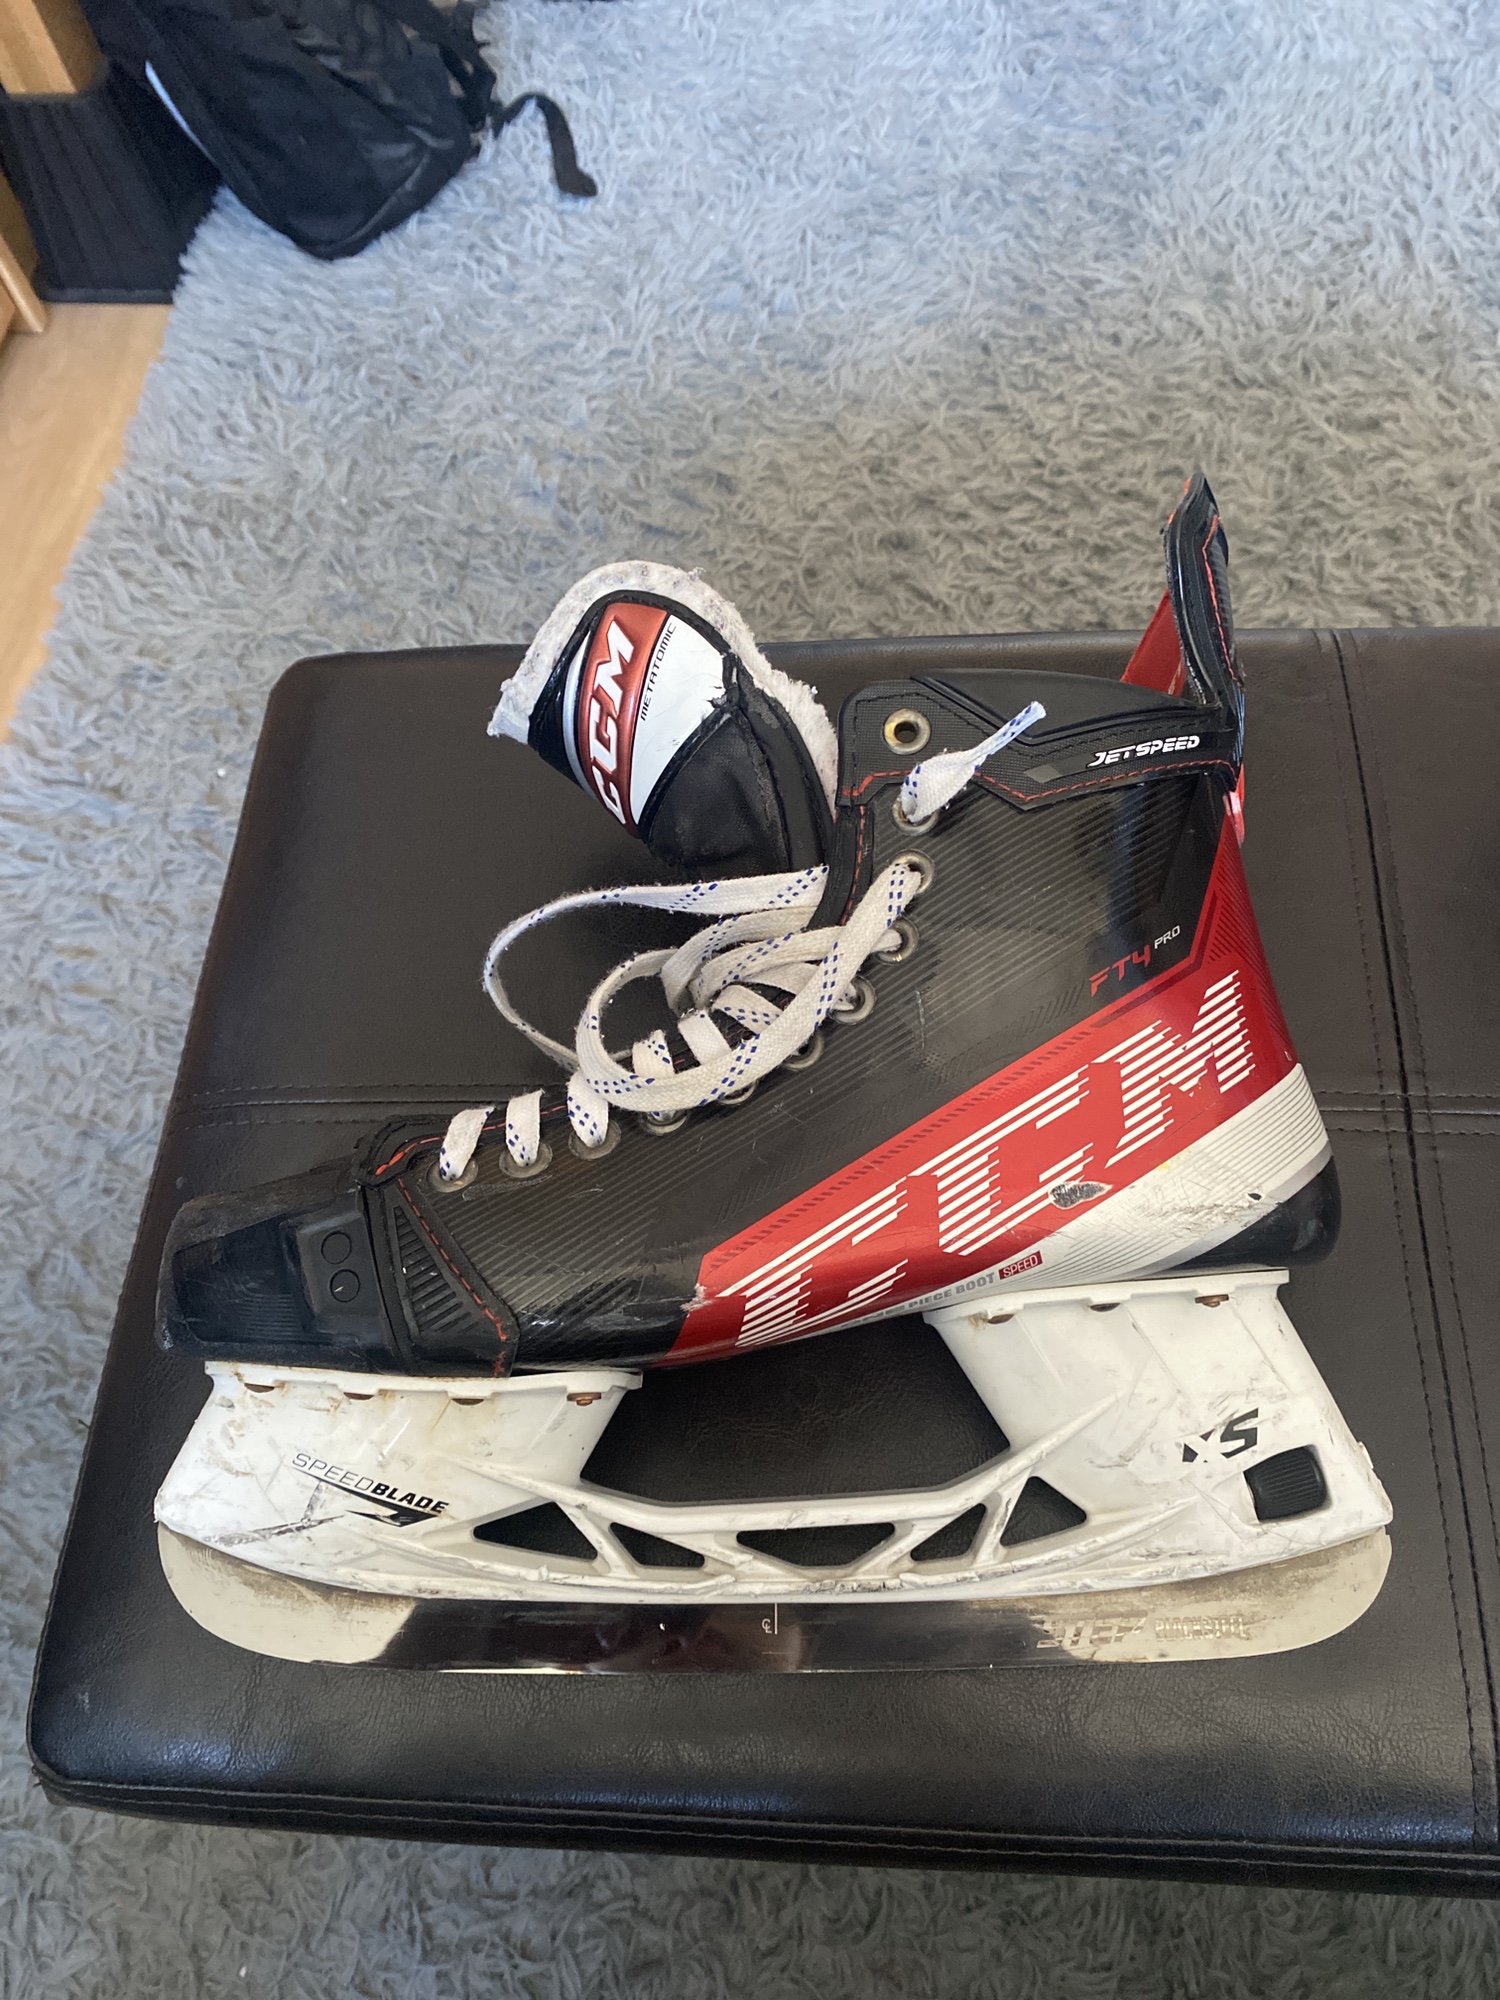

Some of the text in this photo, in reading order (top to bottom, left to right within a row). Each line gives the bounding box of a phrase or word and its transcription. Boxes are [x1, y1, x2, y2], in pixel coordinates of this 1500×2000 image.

[640, 622, 677, 721] METATOMIC
[588, 620, 635, 825] CCM
[1087, 735, 1200, 768] JETSPEED
[1089, 925, 1181, 997] FT4 PRO
[907, 1288, 953, 1309] PIECE
[955, 1272, 996, 1295] BOOT
[1002, 1253, 1039, 1279] SPEED
